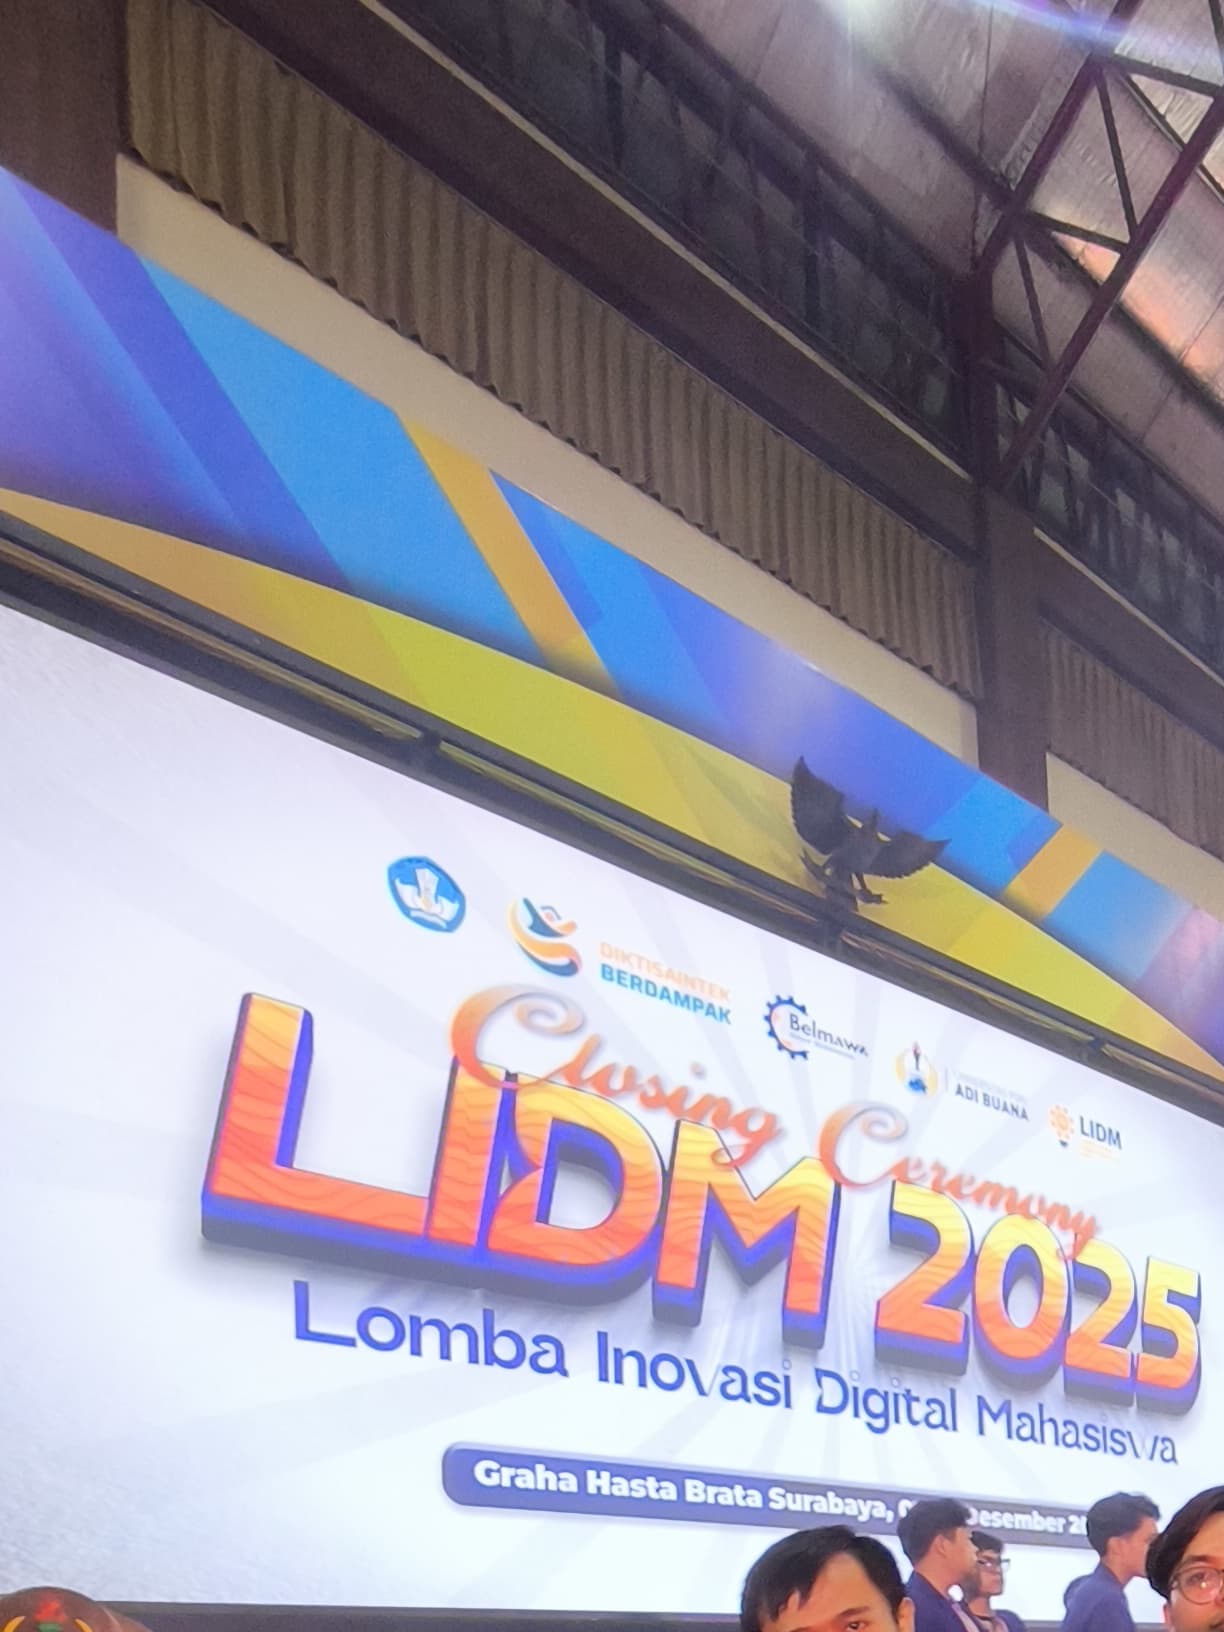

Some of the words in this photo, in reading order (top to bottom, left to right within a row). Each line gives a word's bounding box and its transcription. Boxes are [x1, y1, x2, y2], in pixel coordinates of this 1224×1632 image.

[600, 962, 732, 1025] BERDAMPAK
[450, 984, 786, 1168] Closing
[819, 1102, 1099, 1263] Ceremony
[955, 1083, 979, 1104] ADI
[982, 1092, 1030, 1122] BUANA
[1079, 1115, 1122, 1150] LIDM
[202, 993, 838, 1345] LIDM
[875, 1180, 1201, 1408] 2025
[293, 1279, 569, 1378] Lomba
[597, 1330, 793, 1409] Inovasi
[814, 1367, 958, 1435] Digital
[977, 1395, 1179, 1465] Mahasiswa
[473, 1459, 578, 1495] Graha
[586, 1470, 678, 1502] Hasta
[685, 1479, 763, 1509] Brata
[768, 1487, 895, 1526] Surabaya,
